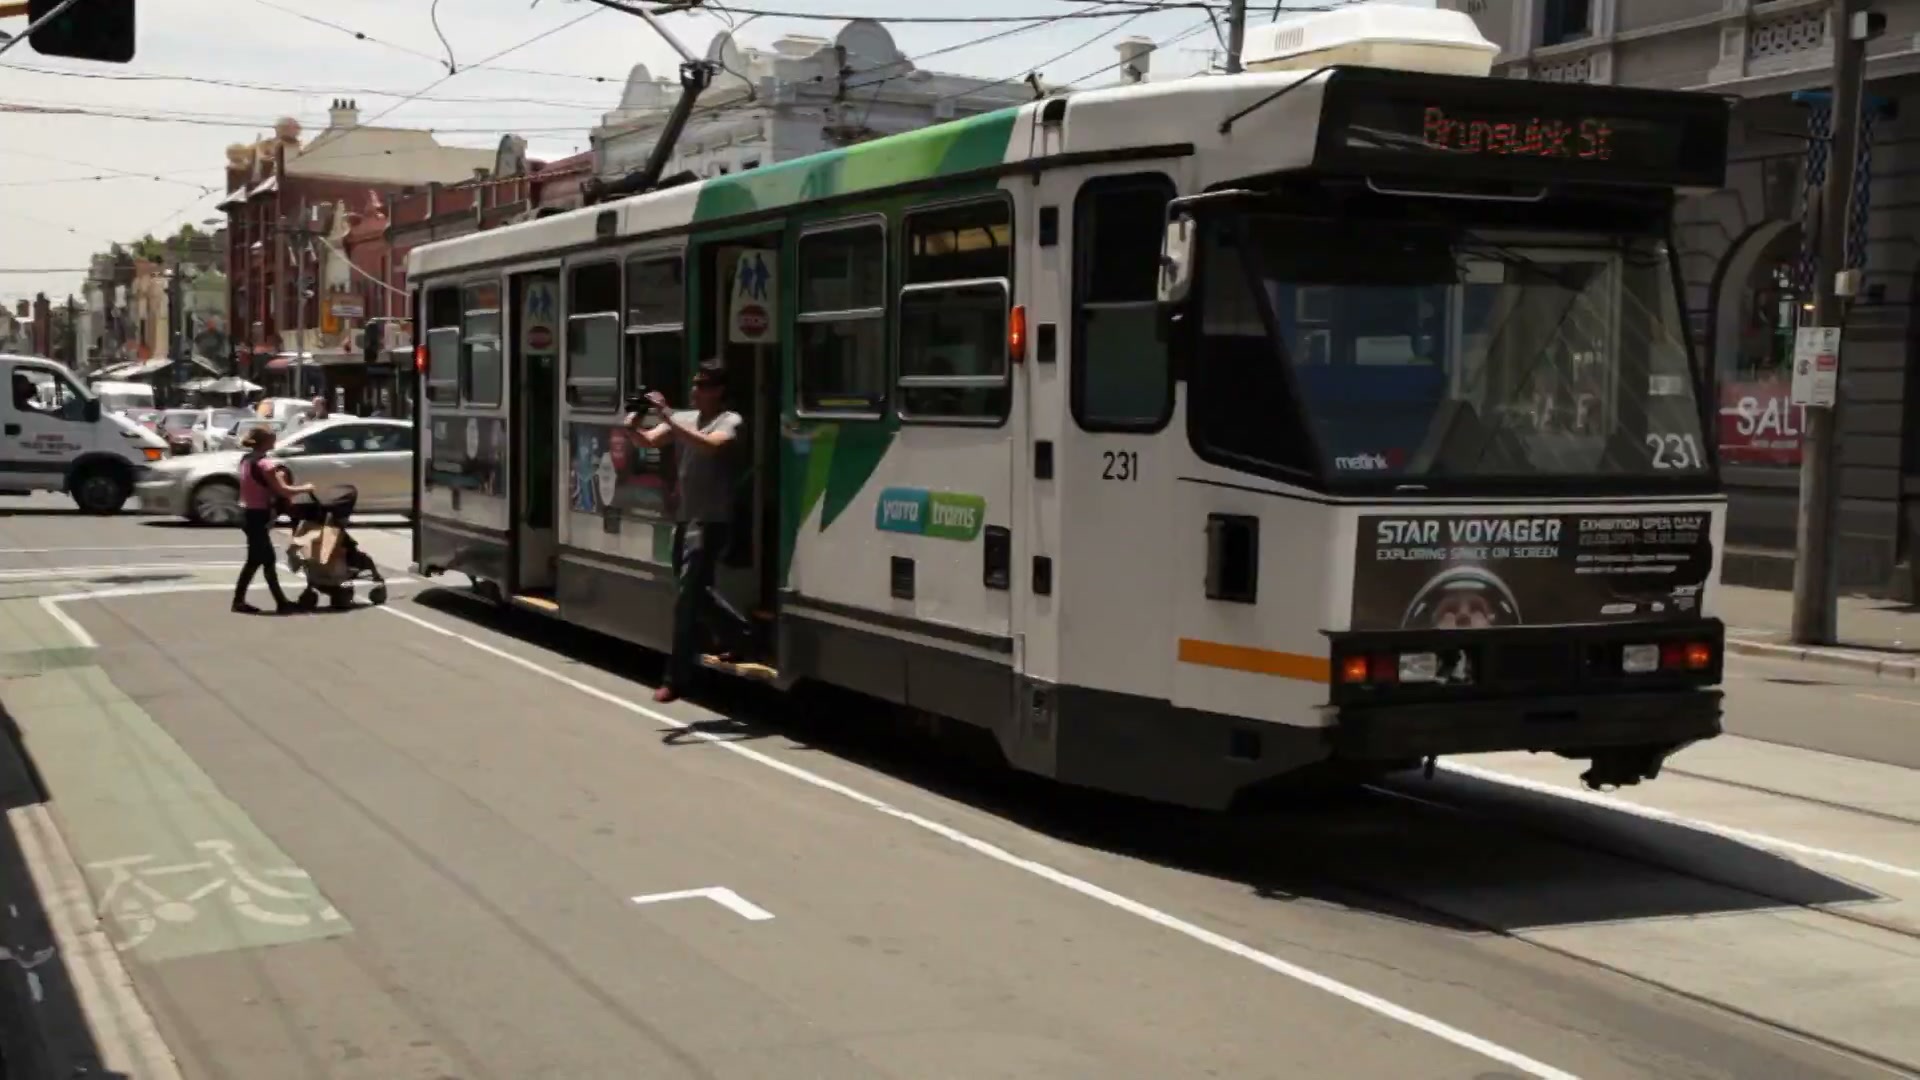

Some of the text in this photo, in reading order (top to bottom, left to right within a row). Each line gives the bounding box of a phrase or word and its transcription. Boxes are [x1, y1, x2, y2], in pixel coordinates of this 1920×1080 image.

[1424, 106, 1614, 160] Brunswick St
[1646, 432, 1701, 469] 231
[1102, 451, 1138, 481] 231
[882, 499, 977, 528] yarra trams
[1376, 520, 1440, 545] STAR
[1448, 518, 1562, 544] VOYAGER
[1376, 547, 1447, 561] EXPLORING
[1514, 546, 1559, 559] SCREEN
